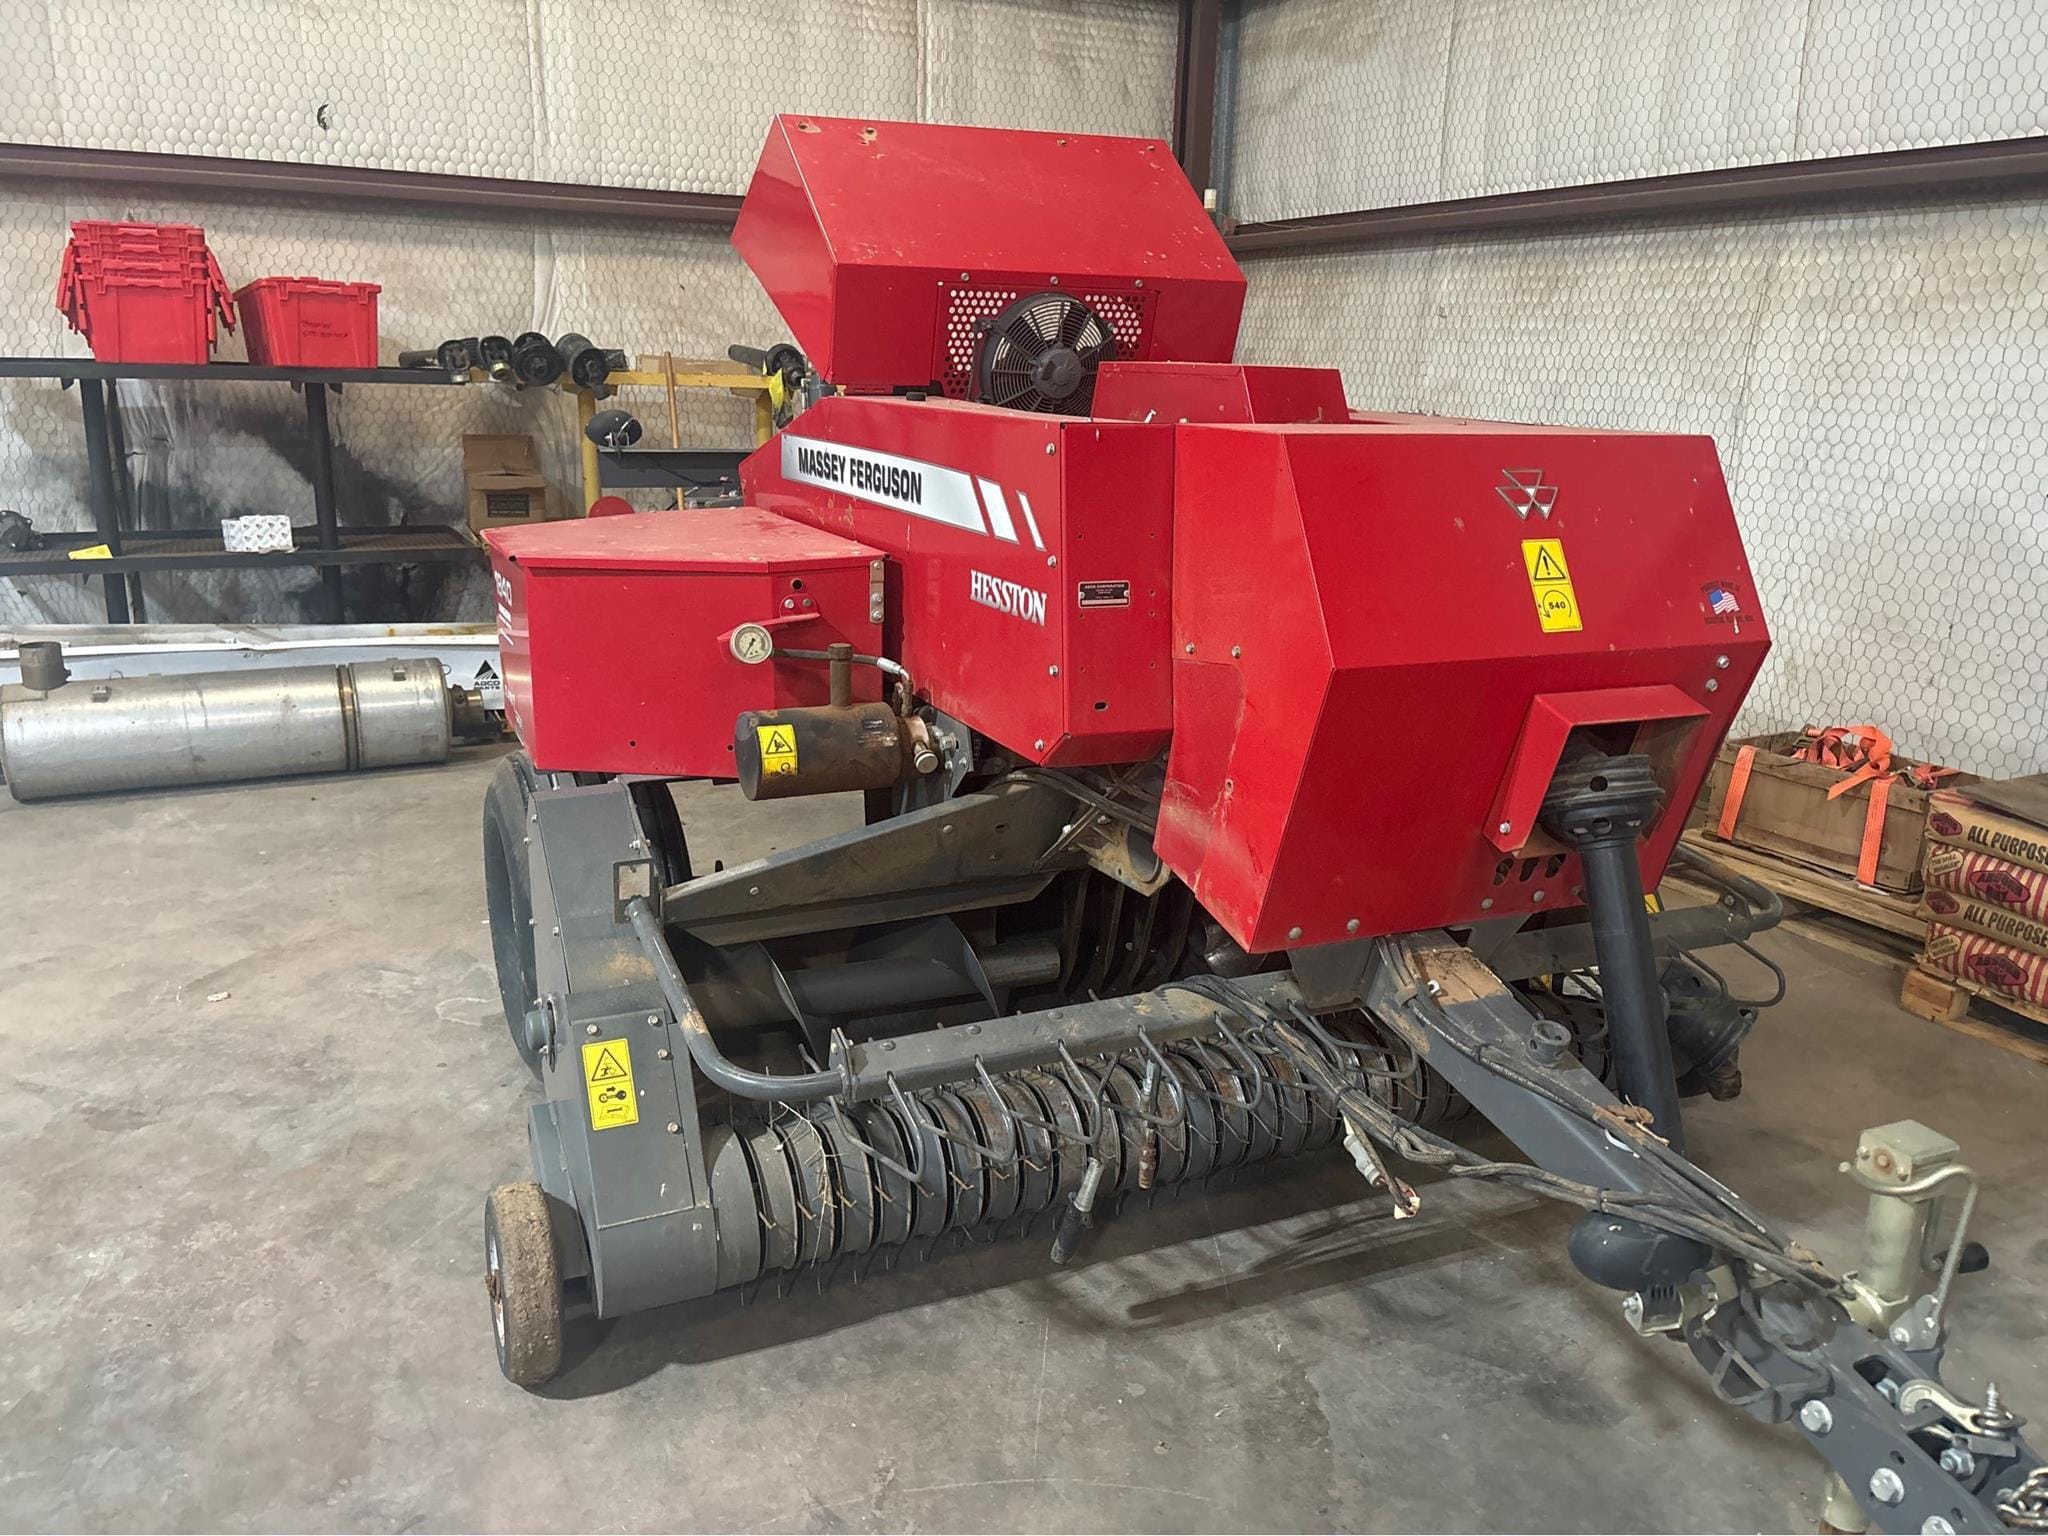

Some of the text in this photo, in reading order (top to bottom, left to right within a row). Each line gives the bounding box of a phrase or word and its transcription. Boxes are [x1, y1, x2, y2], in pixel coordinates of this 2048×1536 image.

[798, 446, 922, 506] MASSEY FERGUSON
[970, 568, 1048, 627] HESSTON
[1548, 601, 1566, 610] 540
[1967, 825, 1990, 847] ALL
[1963, 904, 1987, 926] ALL
